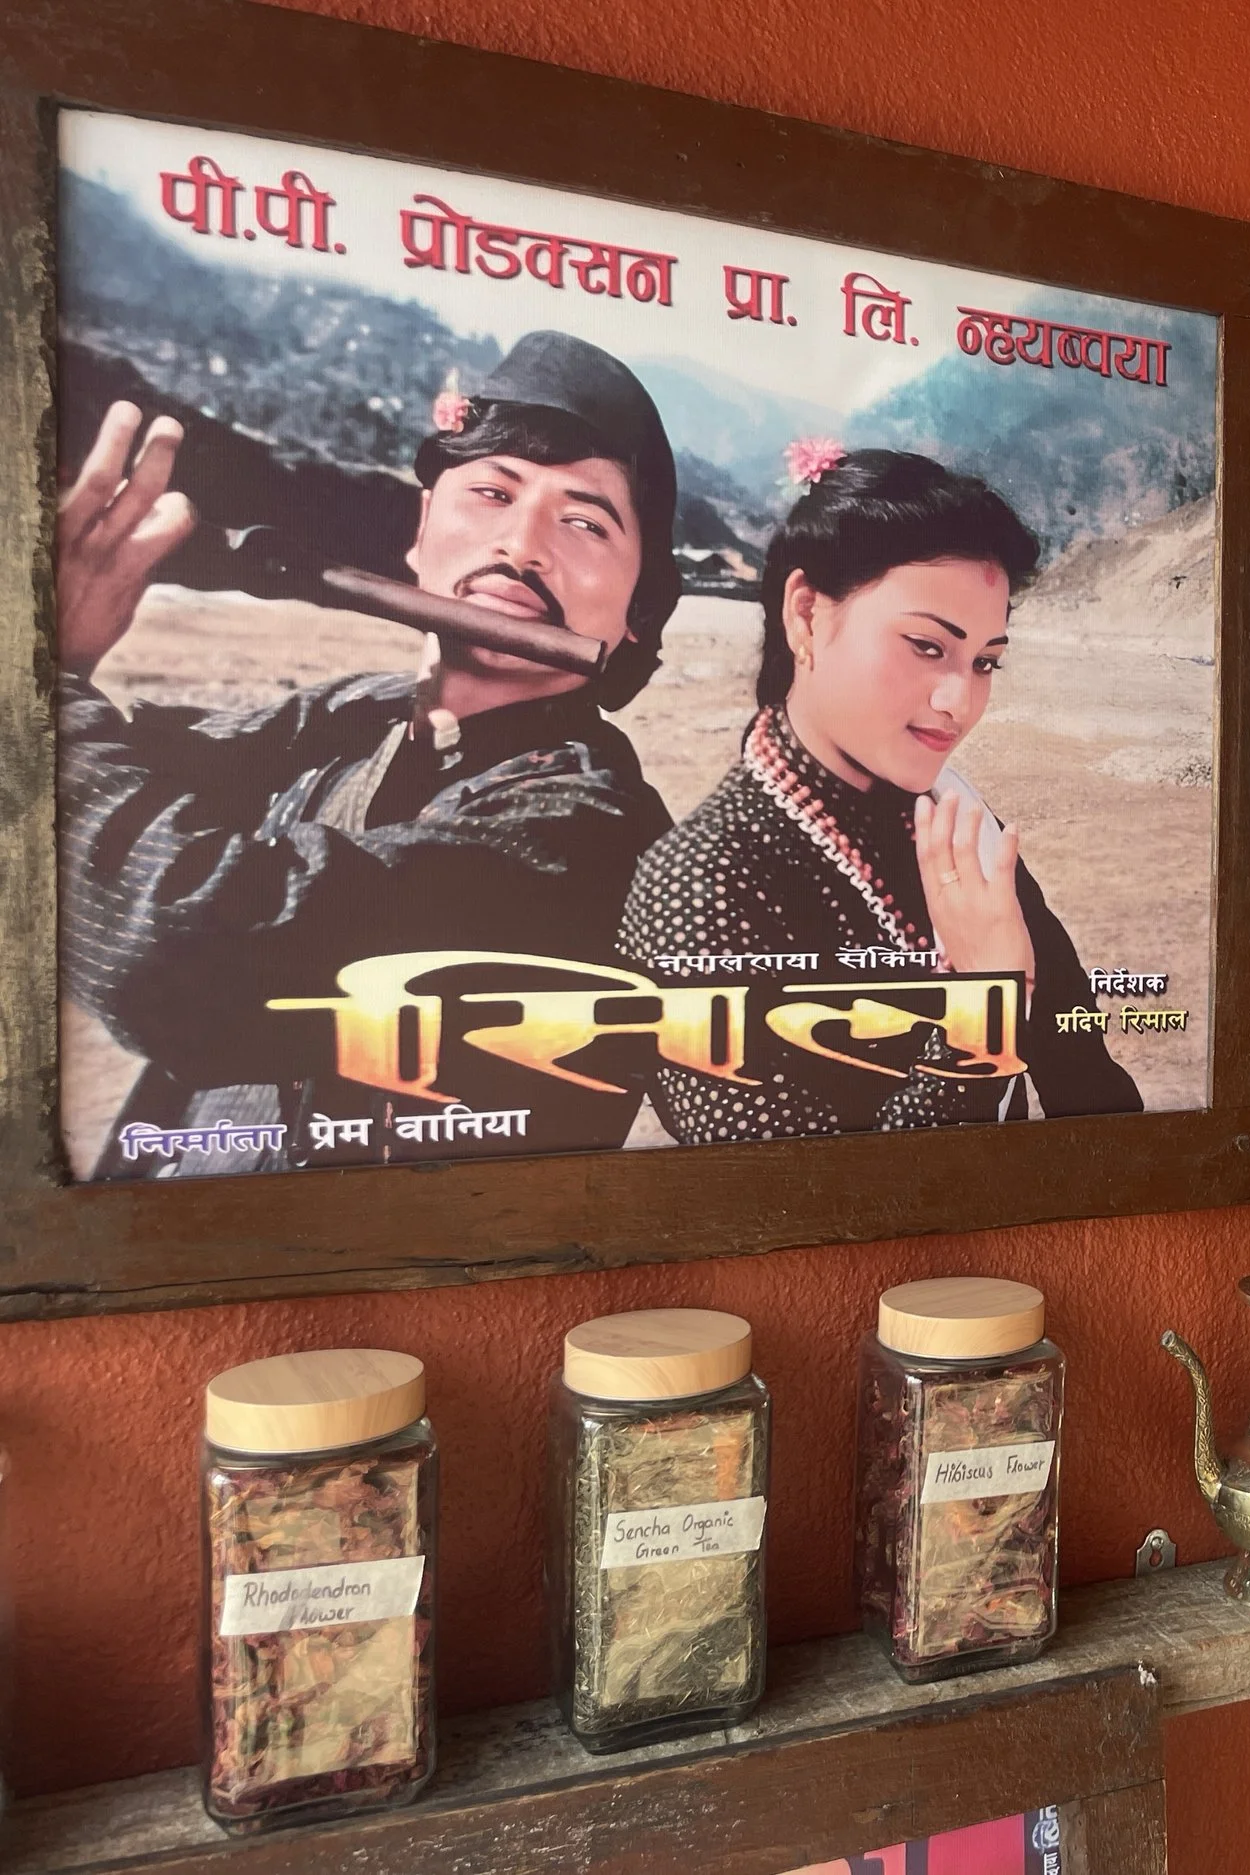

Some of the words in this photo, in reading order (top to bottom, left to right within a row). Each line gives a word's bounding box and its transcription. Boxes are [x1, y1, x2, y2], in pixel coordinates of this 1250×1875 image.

[159, 156, 347, 256] पी.पी.
[400, 194, 679, 306] प्रोडक्सन
[722, 264, 798, 327] प्रा.
[840, 272, 921, 347] लि.
[1088, 967, 1168, 996] निर्देशक
[119, 1118, 288, 1160] निर्माता
[309, 1112, 373, 1150] प्रेम
[395, 1103, 531, 1143] वानिया
[935, 1461, 993, 1484] Hibiscus
[1006, 1454, 1045, 1475] Flower
[614, 1515, 671, 1543] Sencha
[682, 1510, 733, 1539] Organic
